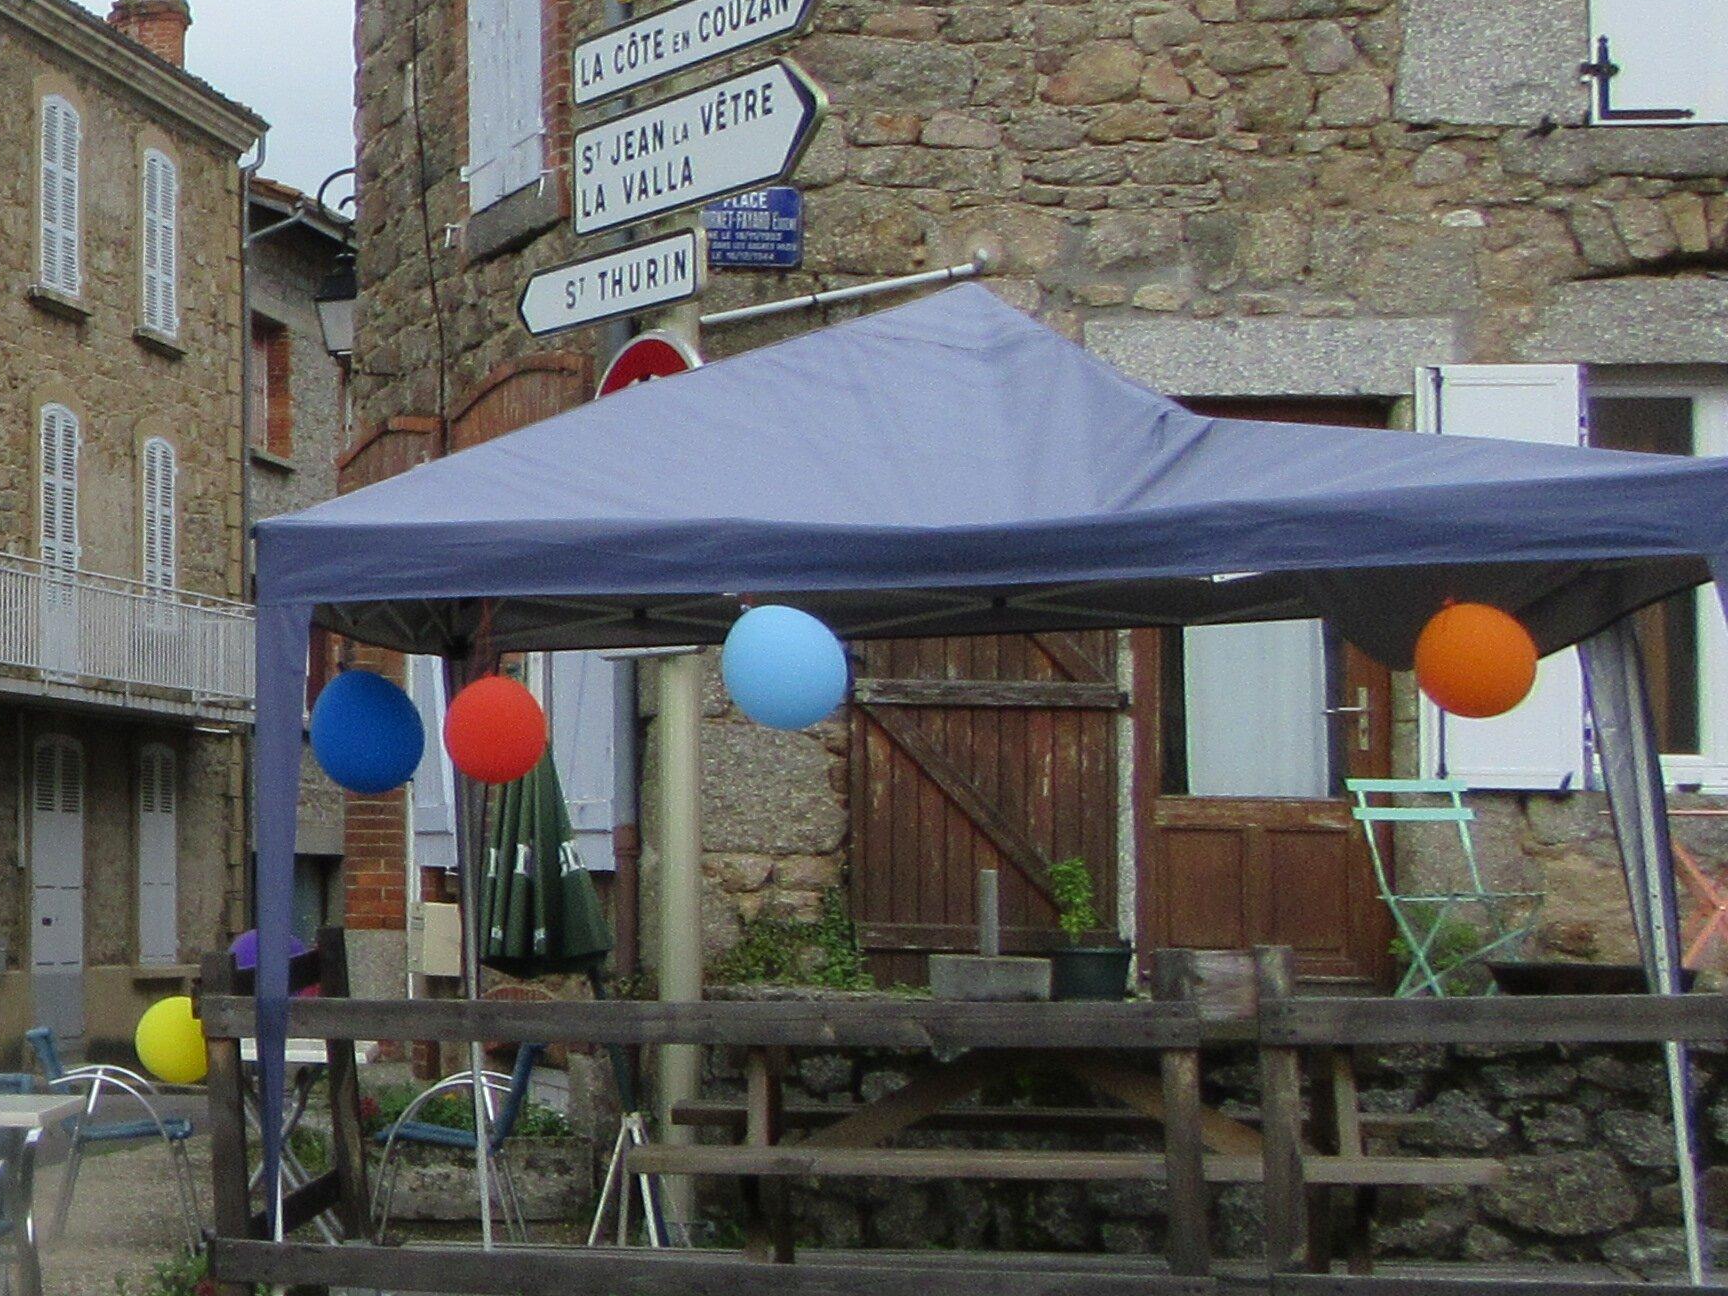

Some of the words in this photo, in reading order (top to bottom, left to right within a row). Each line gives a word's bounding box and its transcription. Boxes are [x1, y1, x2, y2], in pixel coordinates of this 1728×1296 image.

[580, 52, 604, 88] LA
[613, 28, 664, 75] CÔTE
[672, 30, 691, 54] EN
[610, 119, 664, 166] JEAN
[672, 122, 690, 146] LA
[700, 82, 774, 137] VÊTRE
[581, 184, 606, 218] LA
[622, 155, 694, 205] VALLA
[565, 276, 587, 310] ST
[597, 248, 687, 302] THURIN
